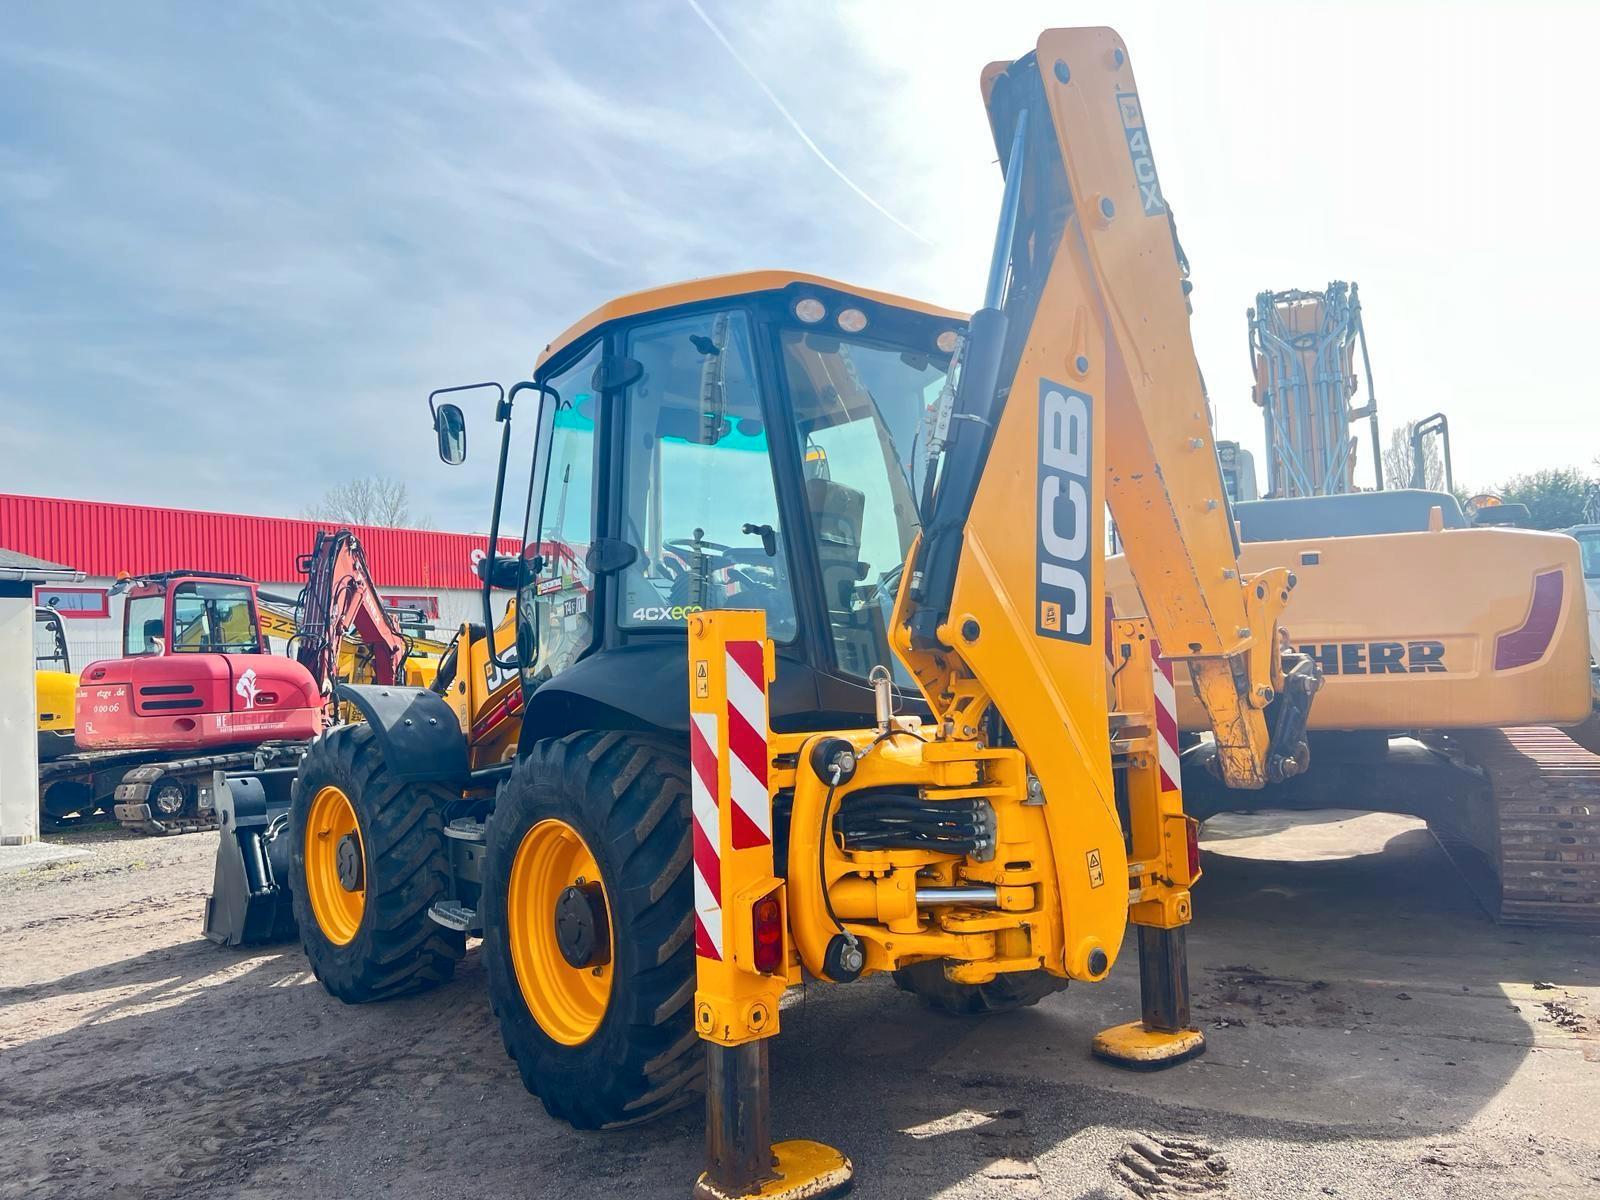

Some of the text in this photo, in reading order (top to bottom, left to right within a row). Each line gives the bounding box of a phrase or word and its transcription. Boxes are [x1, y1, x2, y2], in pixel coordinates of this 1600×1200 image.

[1130, 130, 1163, 210] 4CX
[1041, 390, 1088, 636] JCB
[487, 645, 520, 691] JC
[1292, 640, 1448, 675] HERR
